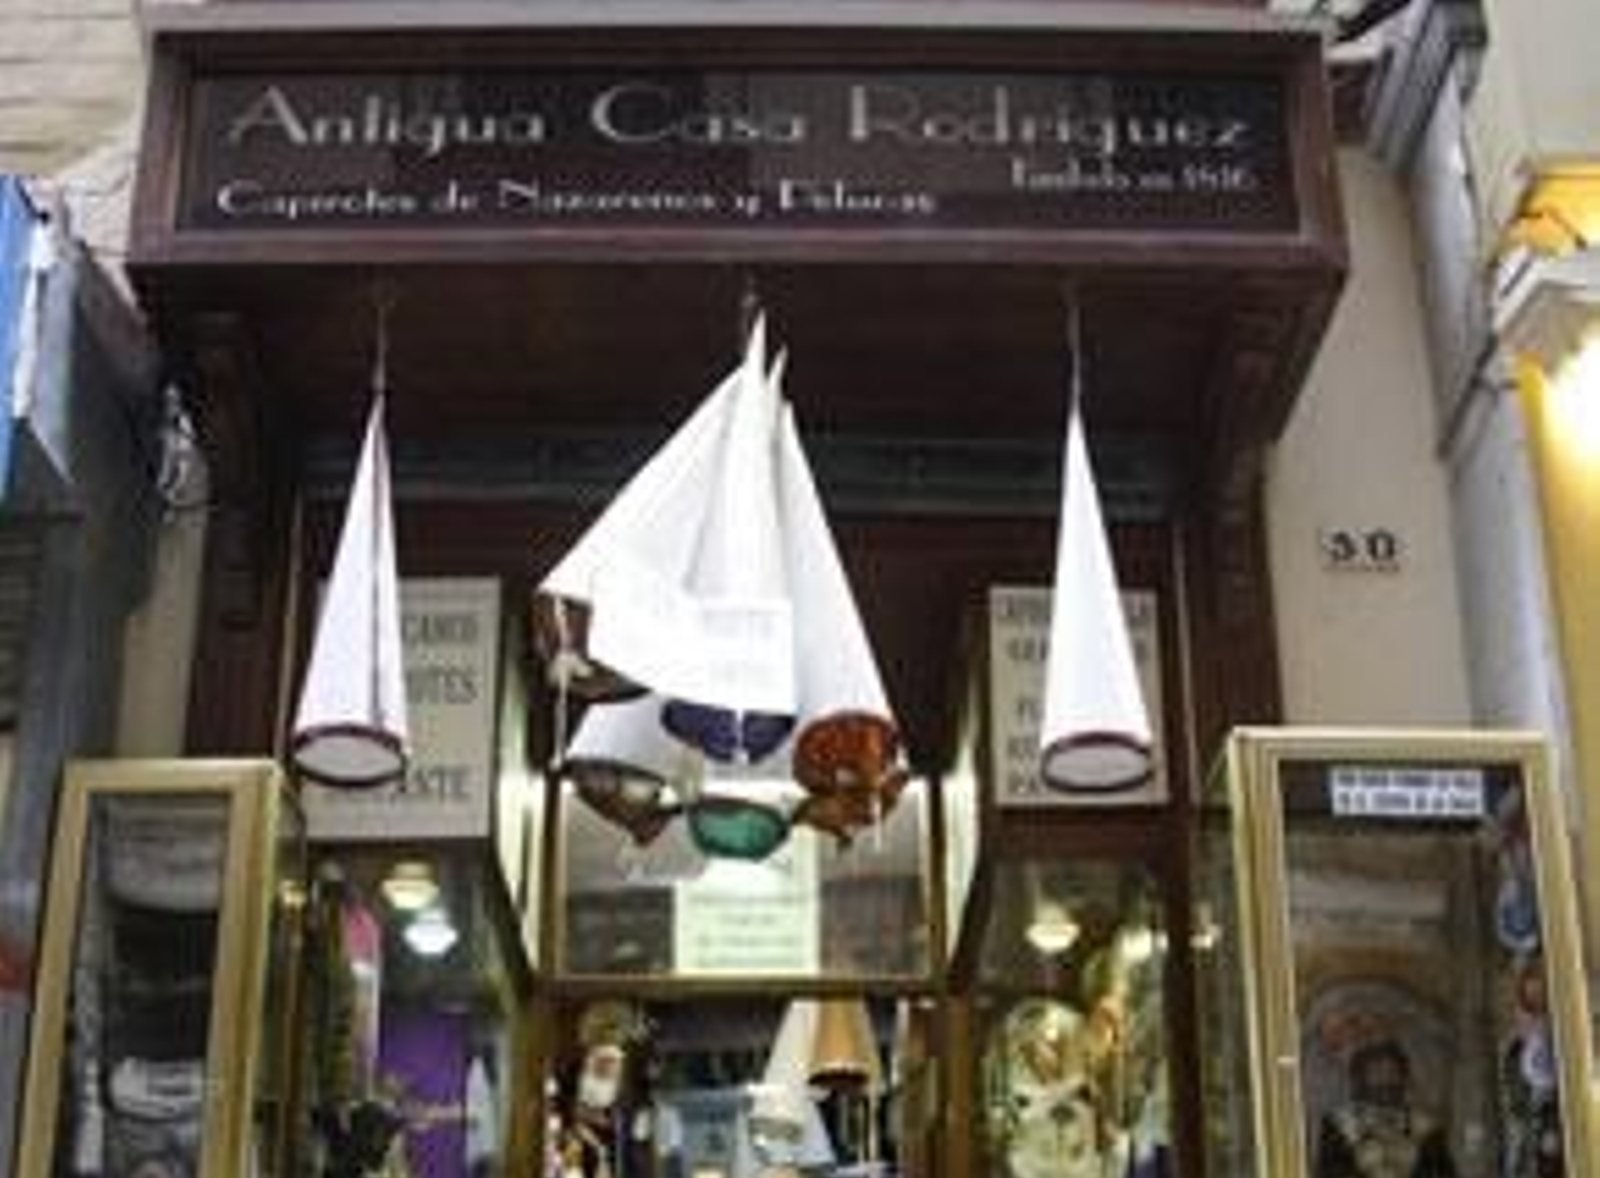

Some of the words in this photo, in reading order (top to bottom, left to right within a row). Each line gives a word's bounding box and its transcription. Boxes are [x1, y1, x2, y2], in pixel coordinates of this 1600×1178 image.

[228, 84, 546, 160] Antigua
[591, 83, 805, 144] Casa
[433, 178, 480, 212] de
[735, 193, 762, 217] y
